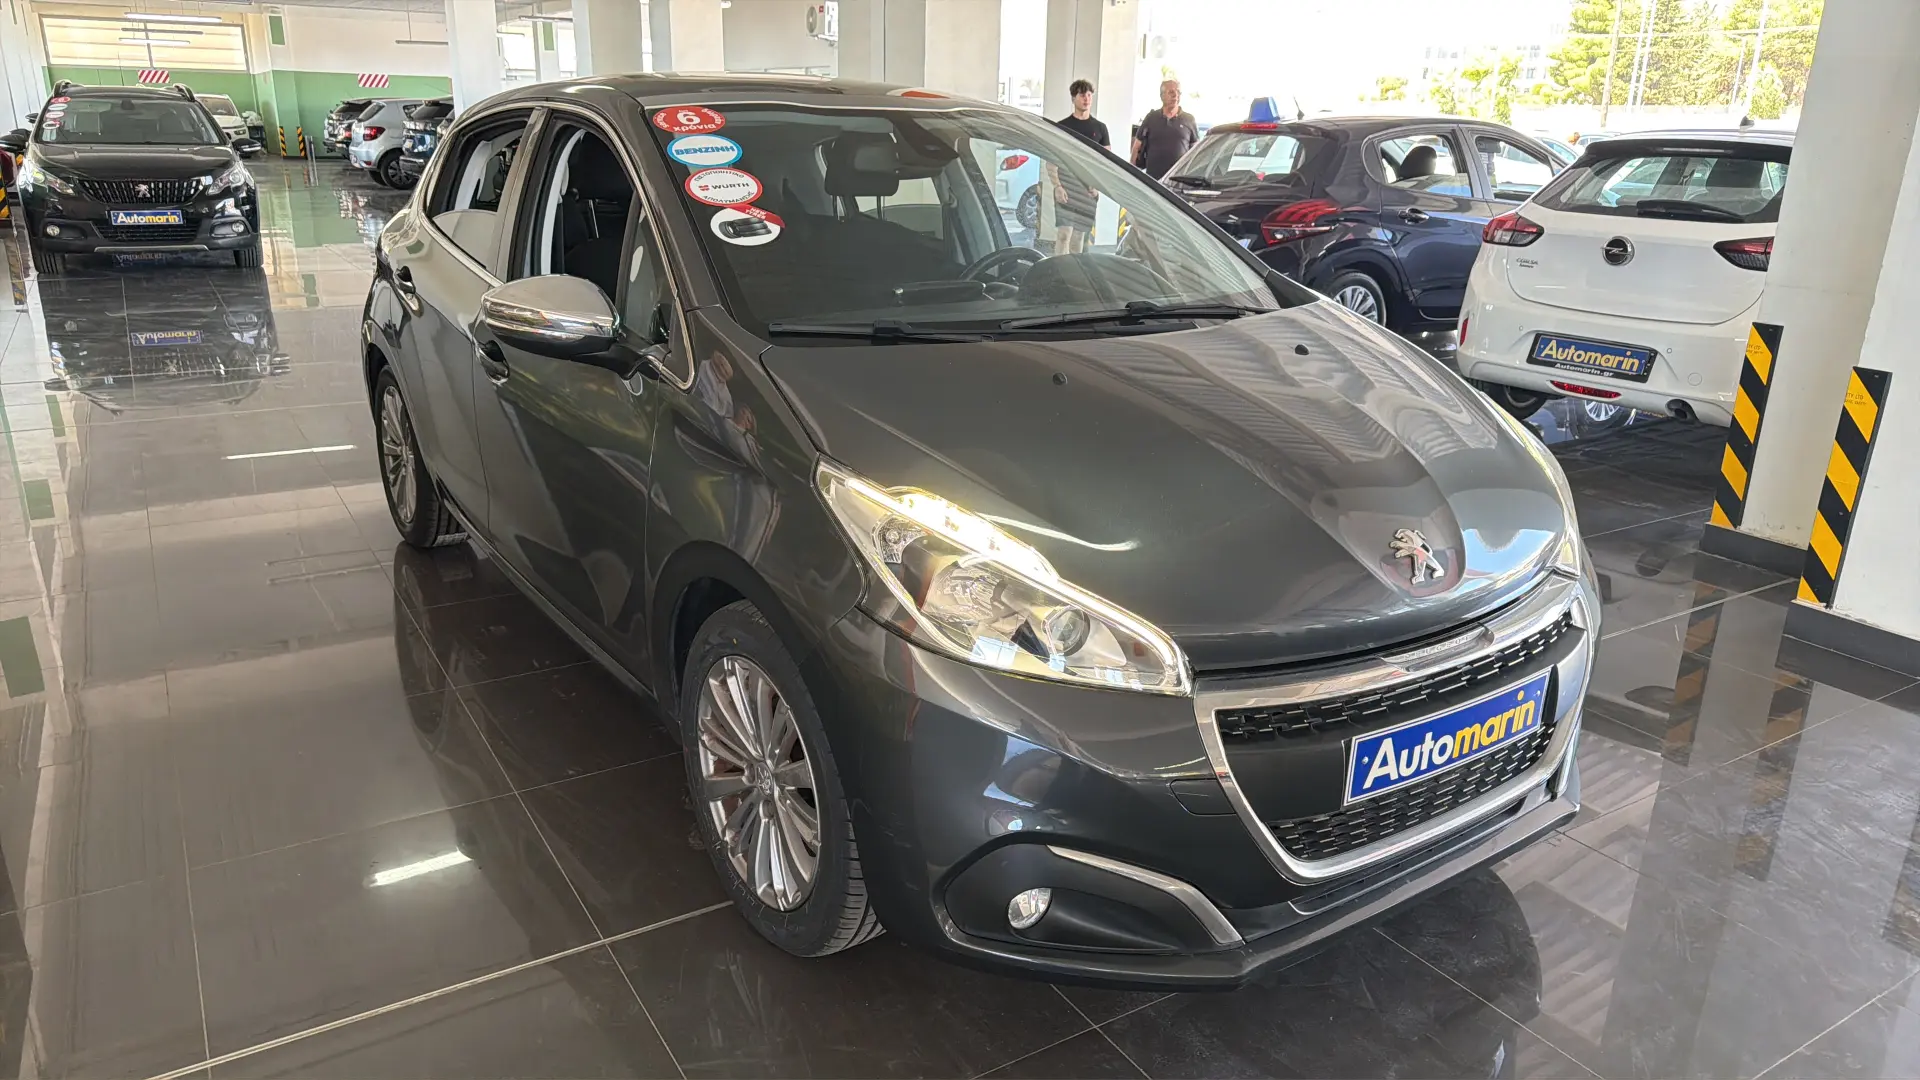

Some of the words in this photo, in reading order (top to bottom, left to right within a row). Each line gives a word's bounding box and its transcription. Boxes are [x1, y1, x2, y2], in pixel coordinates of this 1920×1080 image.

[676, 111, 701, 125] 6
[672, 123, 717, 132] χρόνια
[117, 212, 179, 224] Automarin
[750, 207, 767, 216] NEW
[1540, 340, 1640, 372] Automarin
[1554, 363, 1615, 377] Automarin.gr
[1362, 690, 1536, 790] Automarin
